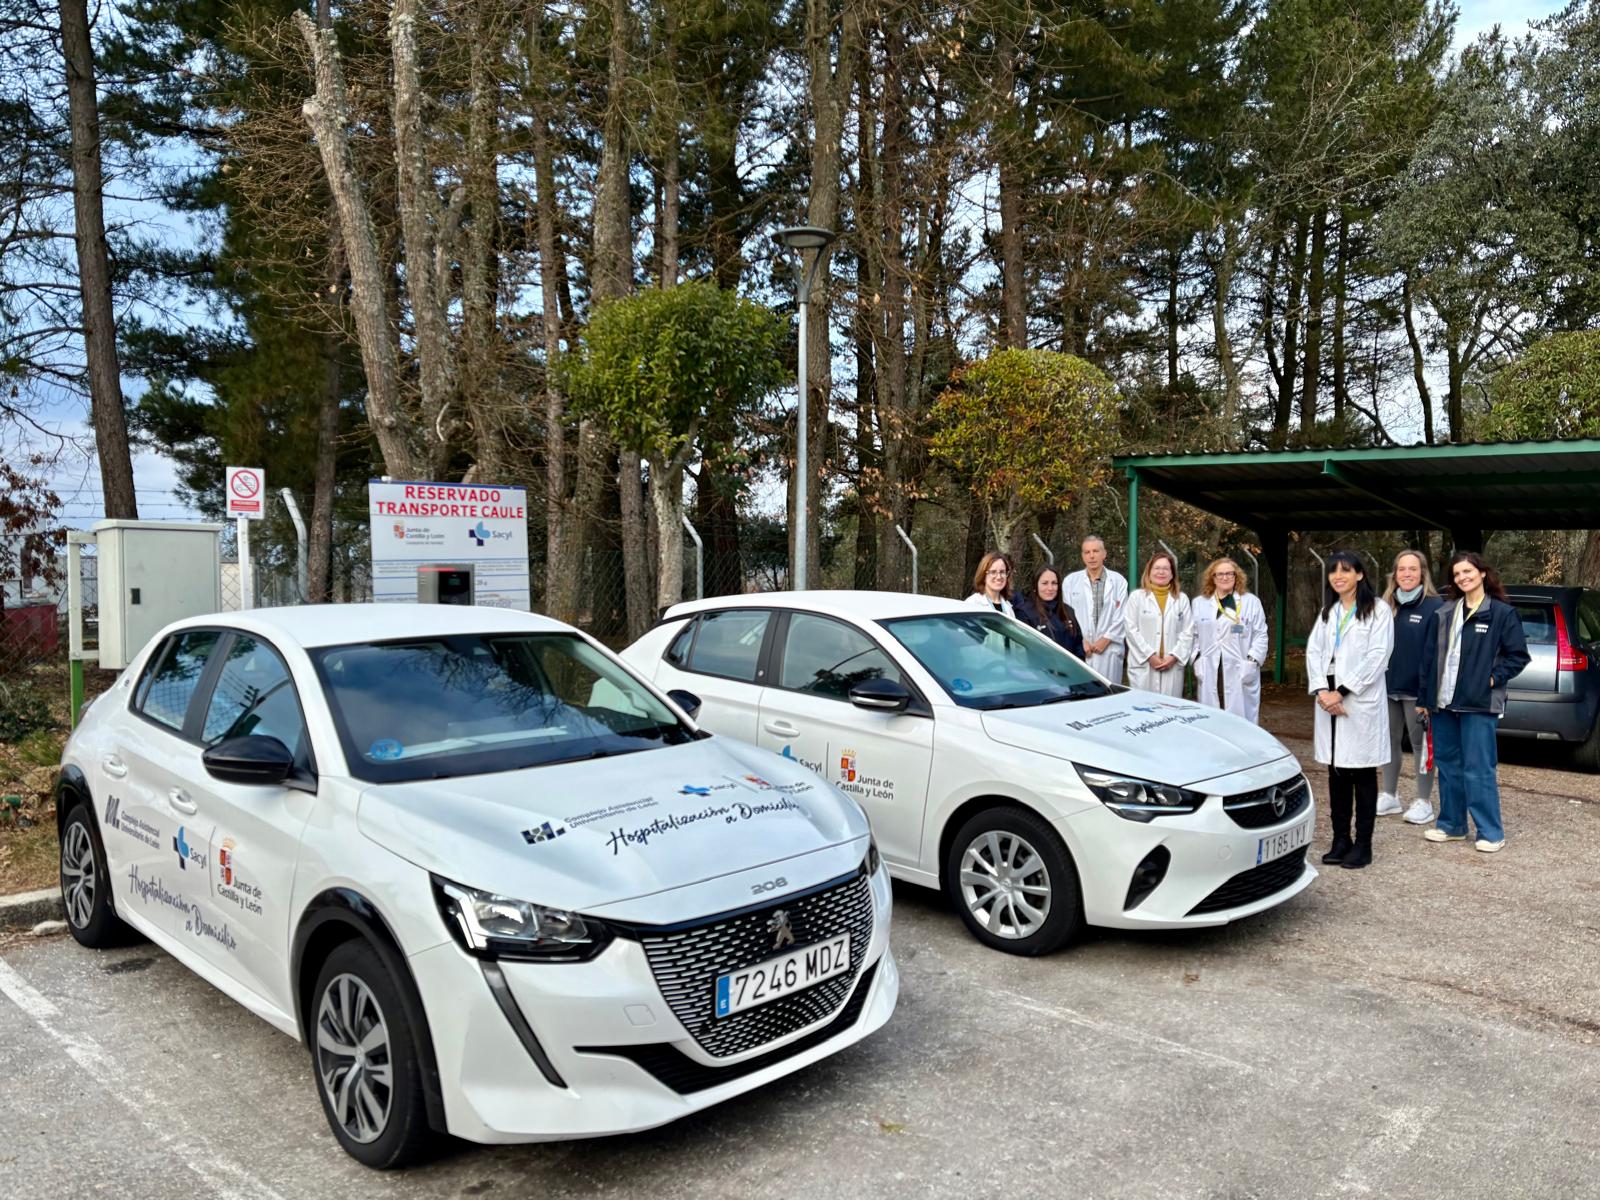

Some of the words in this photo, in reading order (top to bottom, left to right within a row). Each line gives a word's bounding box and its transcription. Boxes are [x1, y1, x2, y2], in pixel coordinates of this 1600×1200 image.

[405, 485, 501, 502] RESERVADO
[376, 501, 477, 517] TRANSPORTE
[481, 505, 524, 519] CAULE
[492, 530, 512, 540] Sacyl
[857, 774, 880, 787] Junta
[882, 779, 894, 789] de
[865, 788, 871, 798] y
[873, 788, 894, 800] León
[725, 815, 737, 824] a
[605, 805, 730, 856] Hospitalización
[1265, 833, 1289, 859] 1185
[189, 847, 207, 869] Sacyl
[233, 876, 251, 894] Junta
[252, 887, 262, 900] de
[751, 876, 788, 895] 208
[217, 884, 239, 904] Castilla
[245, 897, 262, 915] León
[735, 958, 797, 1006] 7246
[805, 940, 844, 981] MDZ
[720, 999, 727, 1009] E
